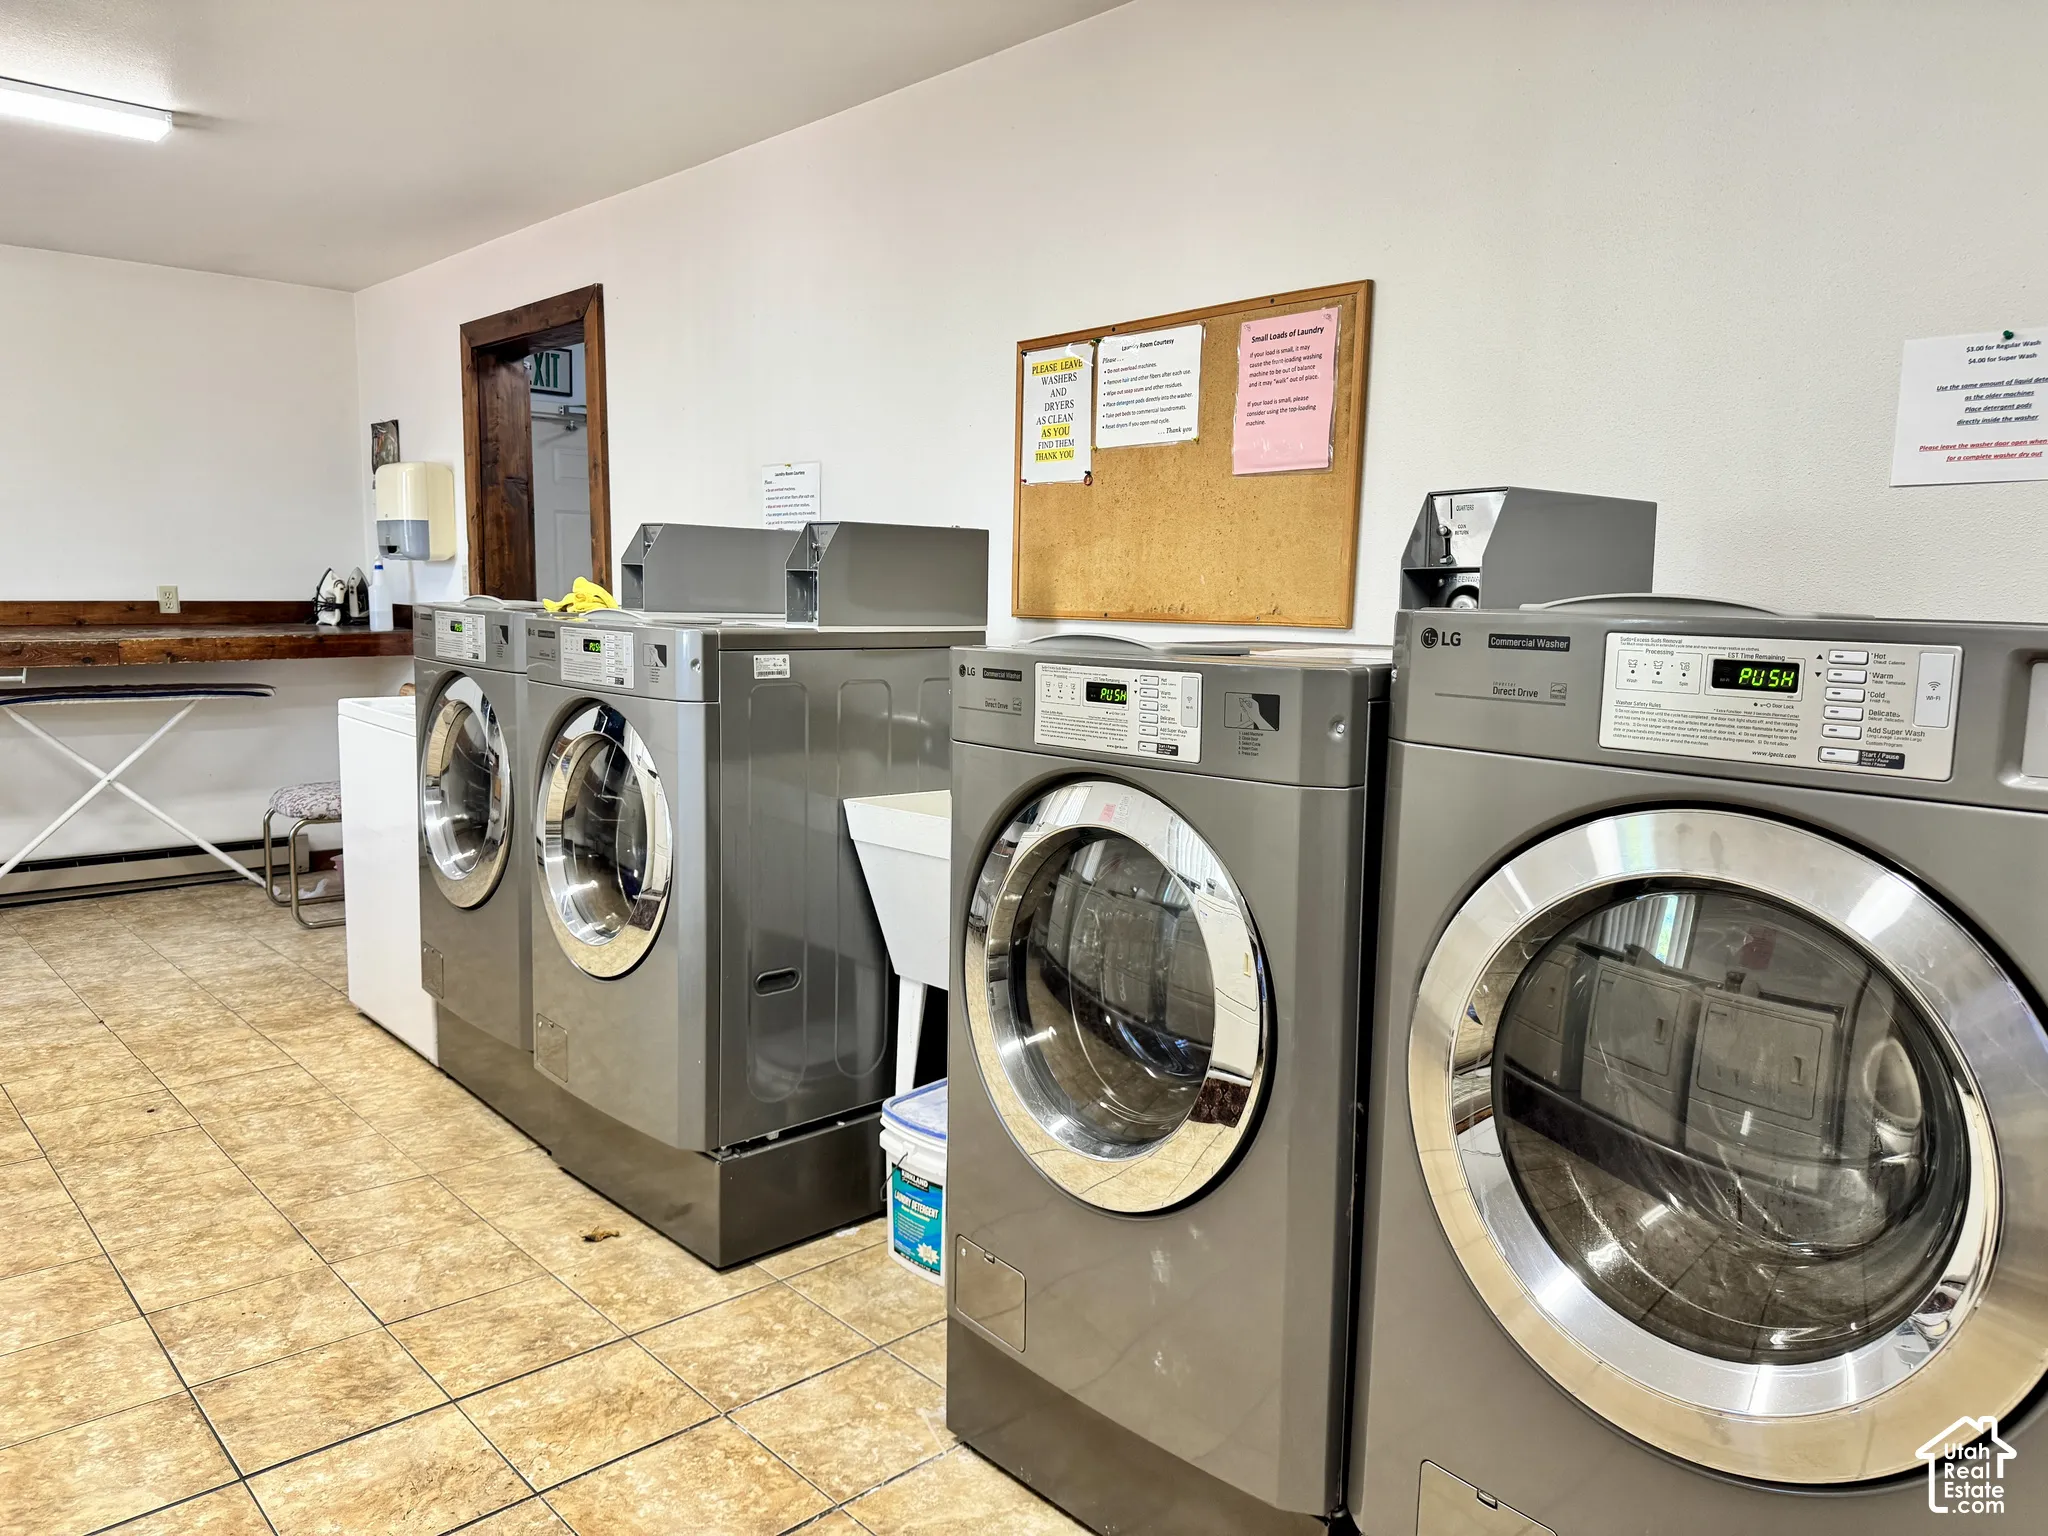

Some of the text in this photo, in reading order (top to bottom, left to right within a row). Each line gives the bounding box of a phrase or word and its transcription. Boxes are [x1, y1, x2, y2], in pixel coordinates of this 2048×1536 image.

[1252, 326, 1324, 343] Small Loads of Laundry
[530, 352, 560, 389] XIT
[1032, 359, 1083, 374] PLEASE LEAVE
[1041, 372, 1077, 386] WASHERS
[1050, 387, 1067, 398] AND
[2003, 390, 2035, 398] machines
[1045, 399, 1074, 411] DRYERS
[1983, 404, 2014, 412] detergent
[1036, 413, 1073, 425] AS CLEAN
[1042, 426, 1070, 437] AS YOU
[1038, 439, 1074, 449] FIND THEM
[1035, 450, 1074, 461] THANK YOU
[1441, 632, 1461, 646] LG
[1490, 637, 1568, 649] Commercial Washer
[1738, 668, 1794, 687] PUSH
[1100, 688, 1127, 701] PUSH
[1492, 686, 1538, 698] Direct Drive
[1868, 709, 1900, 717] Delicates
